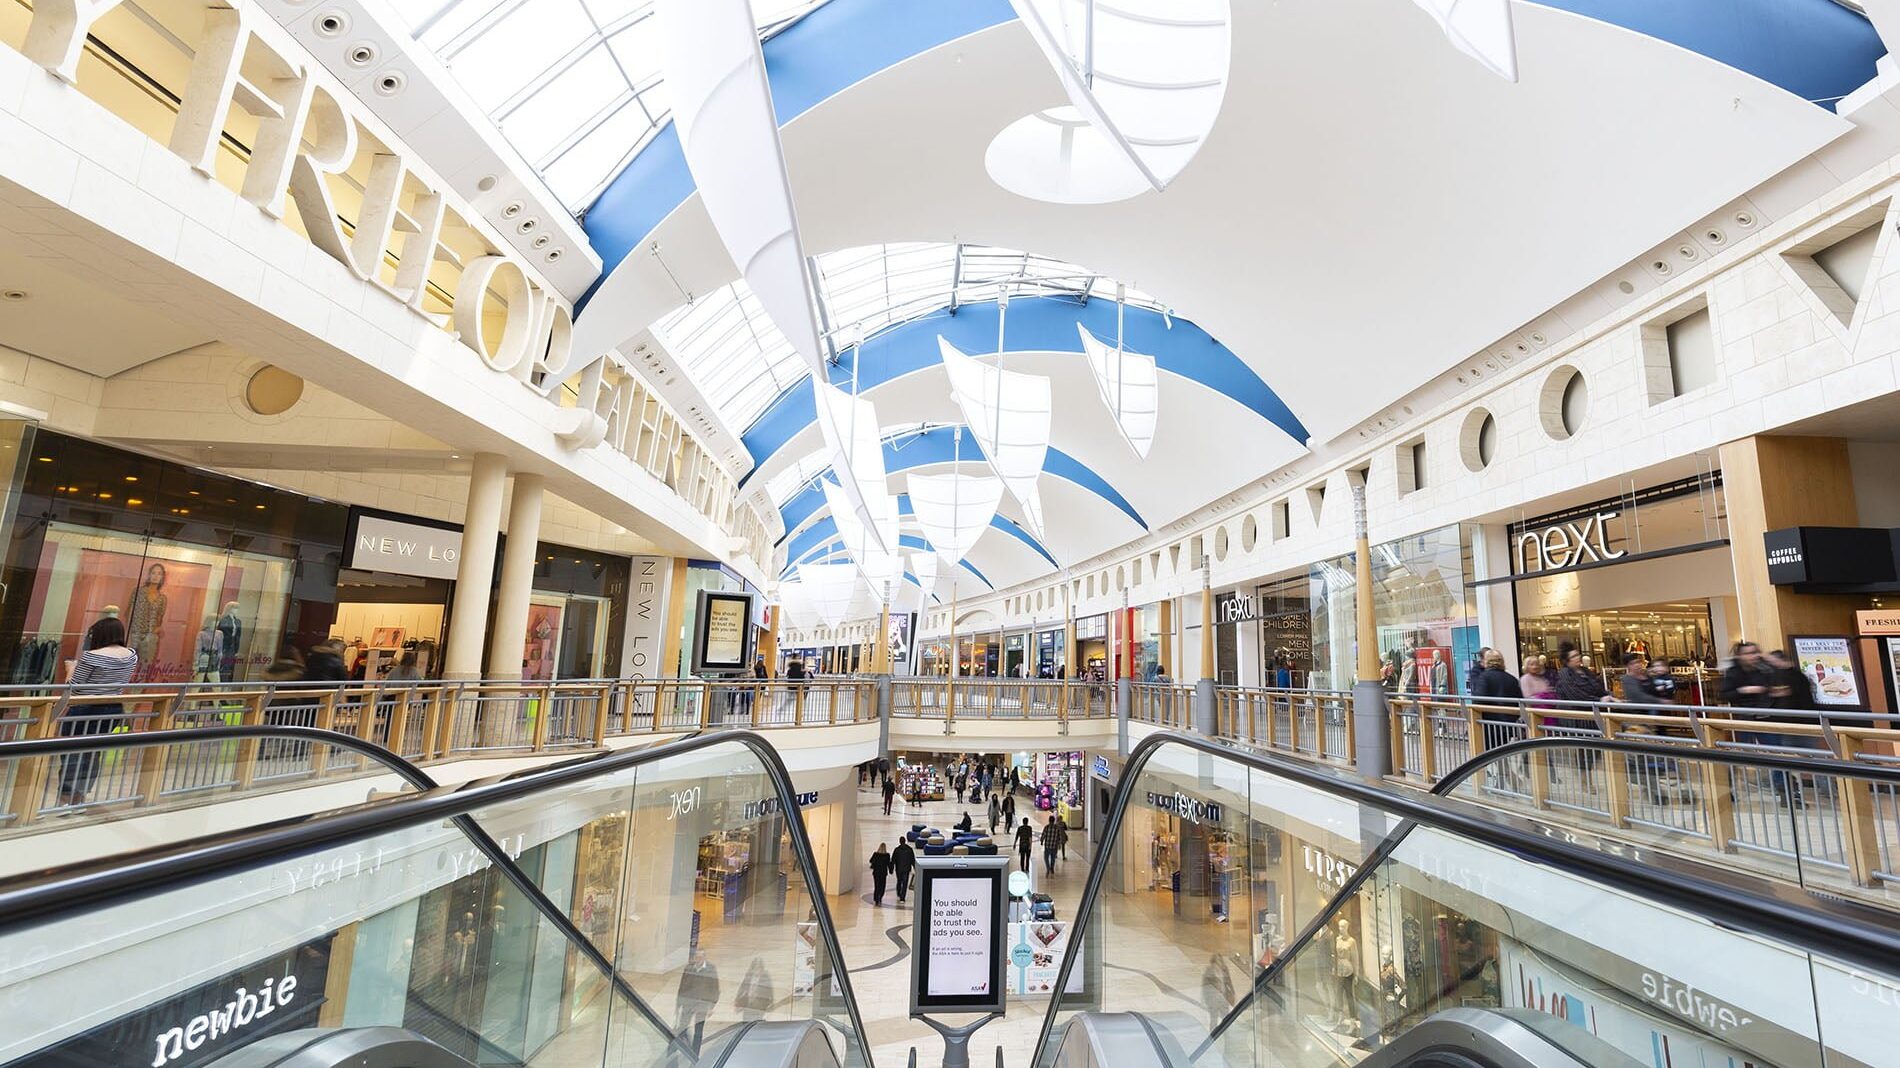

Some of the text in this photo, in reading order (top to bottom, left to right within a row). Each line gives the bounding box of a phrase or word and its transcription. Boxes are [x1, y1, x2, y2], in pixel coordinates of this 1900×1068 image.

[360, 535, 456, 563] NEW LO
[1518, 512, 1626, 575] next
[1771, 547, 1797, 557] COFFEE
[1768, 554, 1802, 566] REPUBLIC
[637, 561, 656, 620] NEW
[1221, 594, 1253, 622] next
[1263, 620, 1309, 629] CHILDREN
[1288, 640, 1310, 648] MEN
[1281, 651, 1310, 660] HOME
[951, 899, 978, 907] should
[152, 975, 297, 1068] newbie
